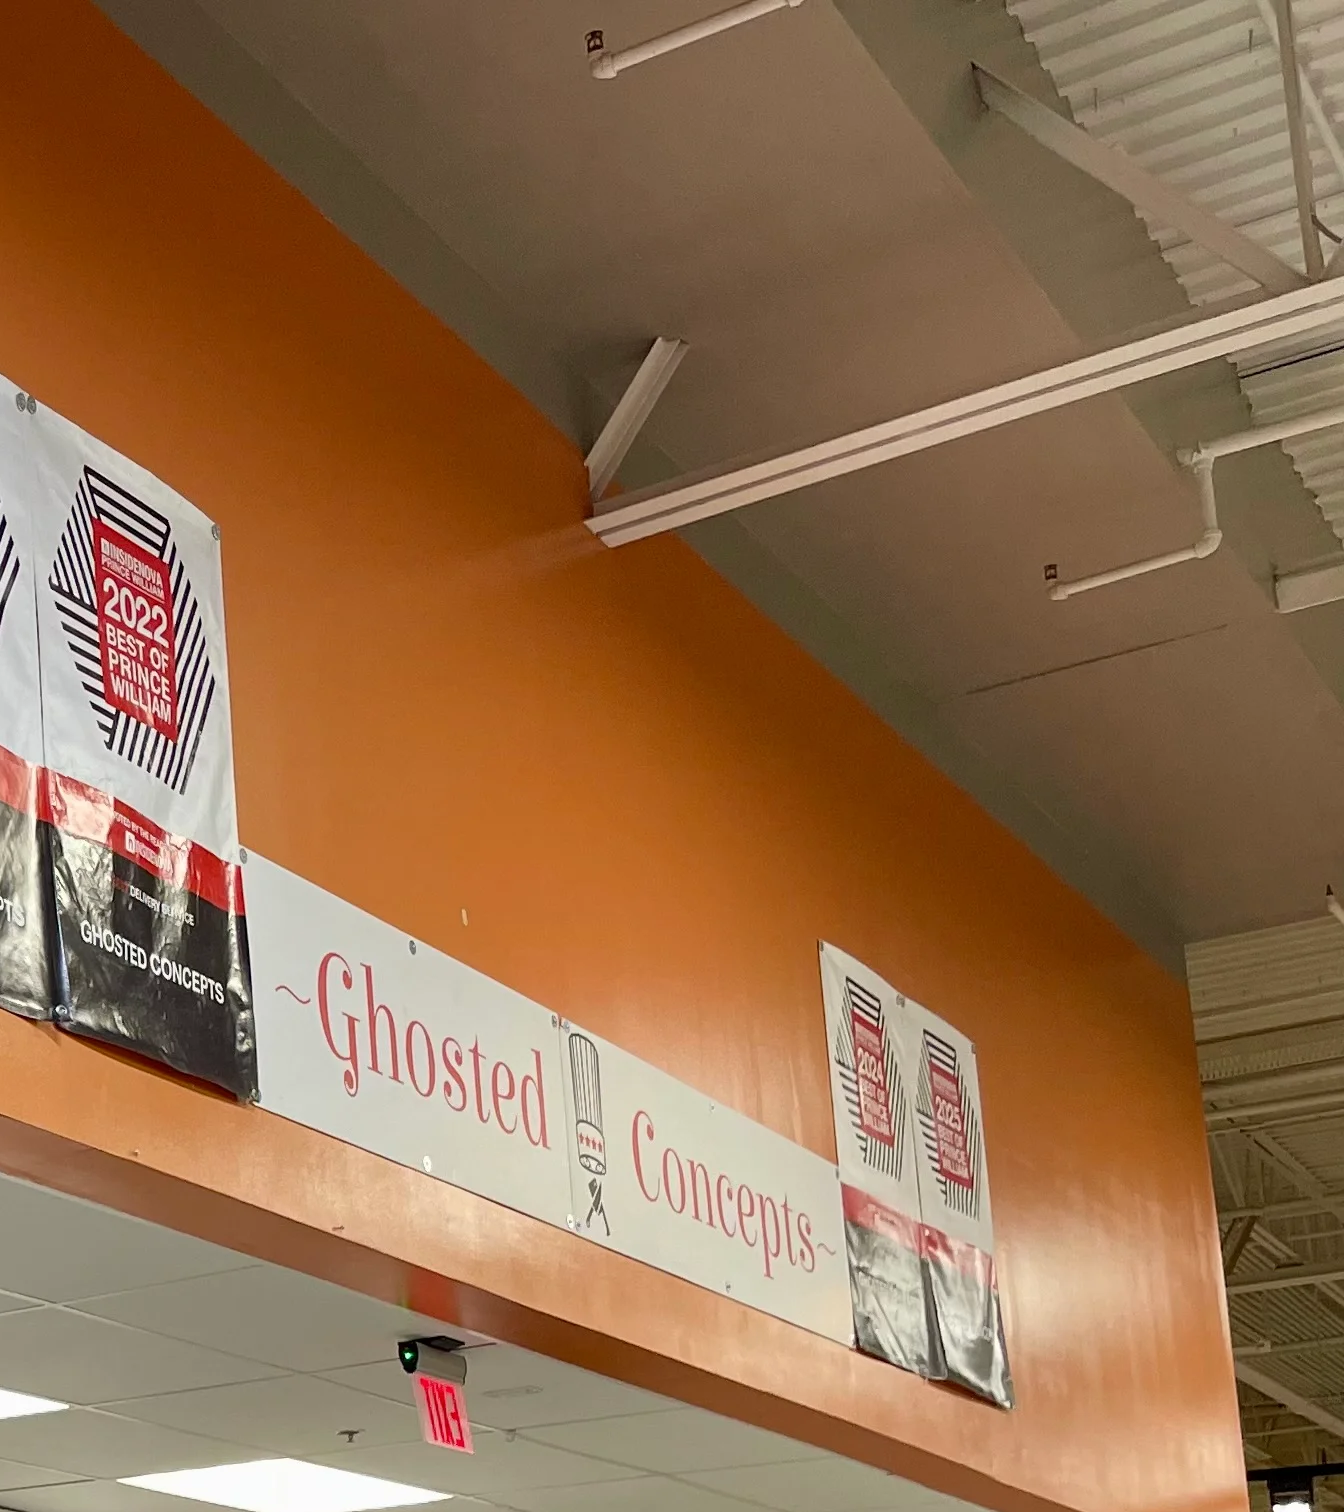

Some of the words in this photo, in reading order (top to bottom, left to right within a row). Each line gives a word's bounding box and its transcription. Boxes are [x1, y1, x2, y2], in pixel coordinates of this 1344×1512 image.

[101, 553, 131, 581] PRINCE
[103, 577, 170, 648] 2022
[106, 622, 146, 662] BEST
[149, 647, 169, 674] OF
[108, 647, 172, 702] PRINCE
[110, 672, 172, 725] WILLIAM
[130, 885, 161, 913] DELIVERY
[80, 919, 148, 971] GHOSTED
[149, 953, 225, 1005] CONCEPTS
[935, 1094, 962, 1133] 2025
